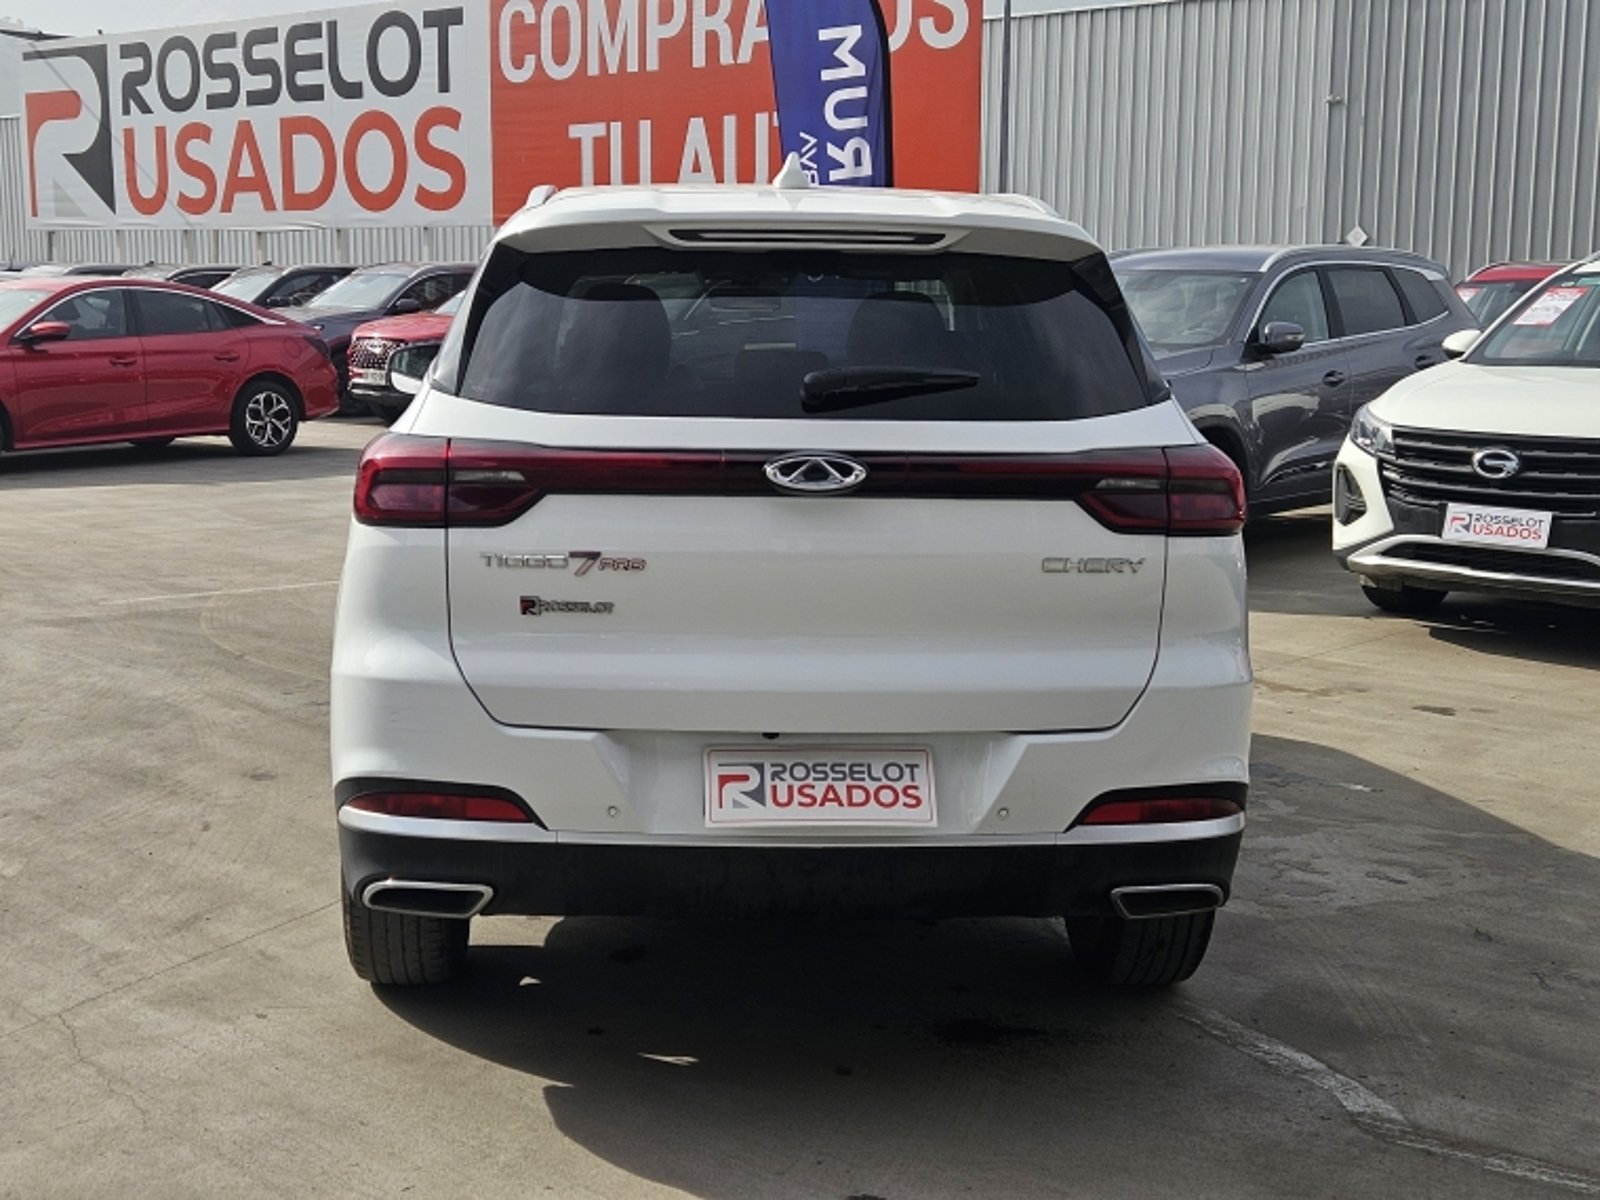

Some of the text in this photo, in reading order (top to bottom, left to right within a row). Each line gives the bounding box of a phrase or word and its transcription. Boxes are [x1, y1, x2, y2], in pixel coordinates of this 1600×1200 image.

[499, 0, 969, 82] COMPRAS
[119, 7, 464, 116] ROSSELOT
[123, 106, 467, 215] USADOS
[676, 111, 781, 187] AU
[1473, 524, 1541, 540] USADOS
[1474, 513, 1544, 527] ROSSELOT
[481, 551, 646, 576] TIGGO 7 PRO
[1042, 557, 1145, 573] CHERY
[770, 762, 920, 782] ROSSELOT
[771, 784, 922, 809] USADOS
